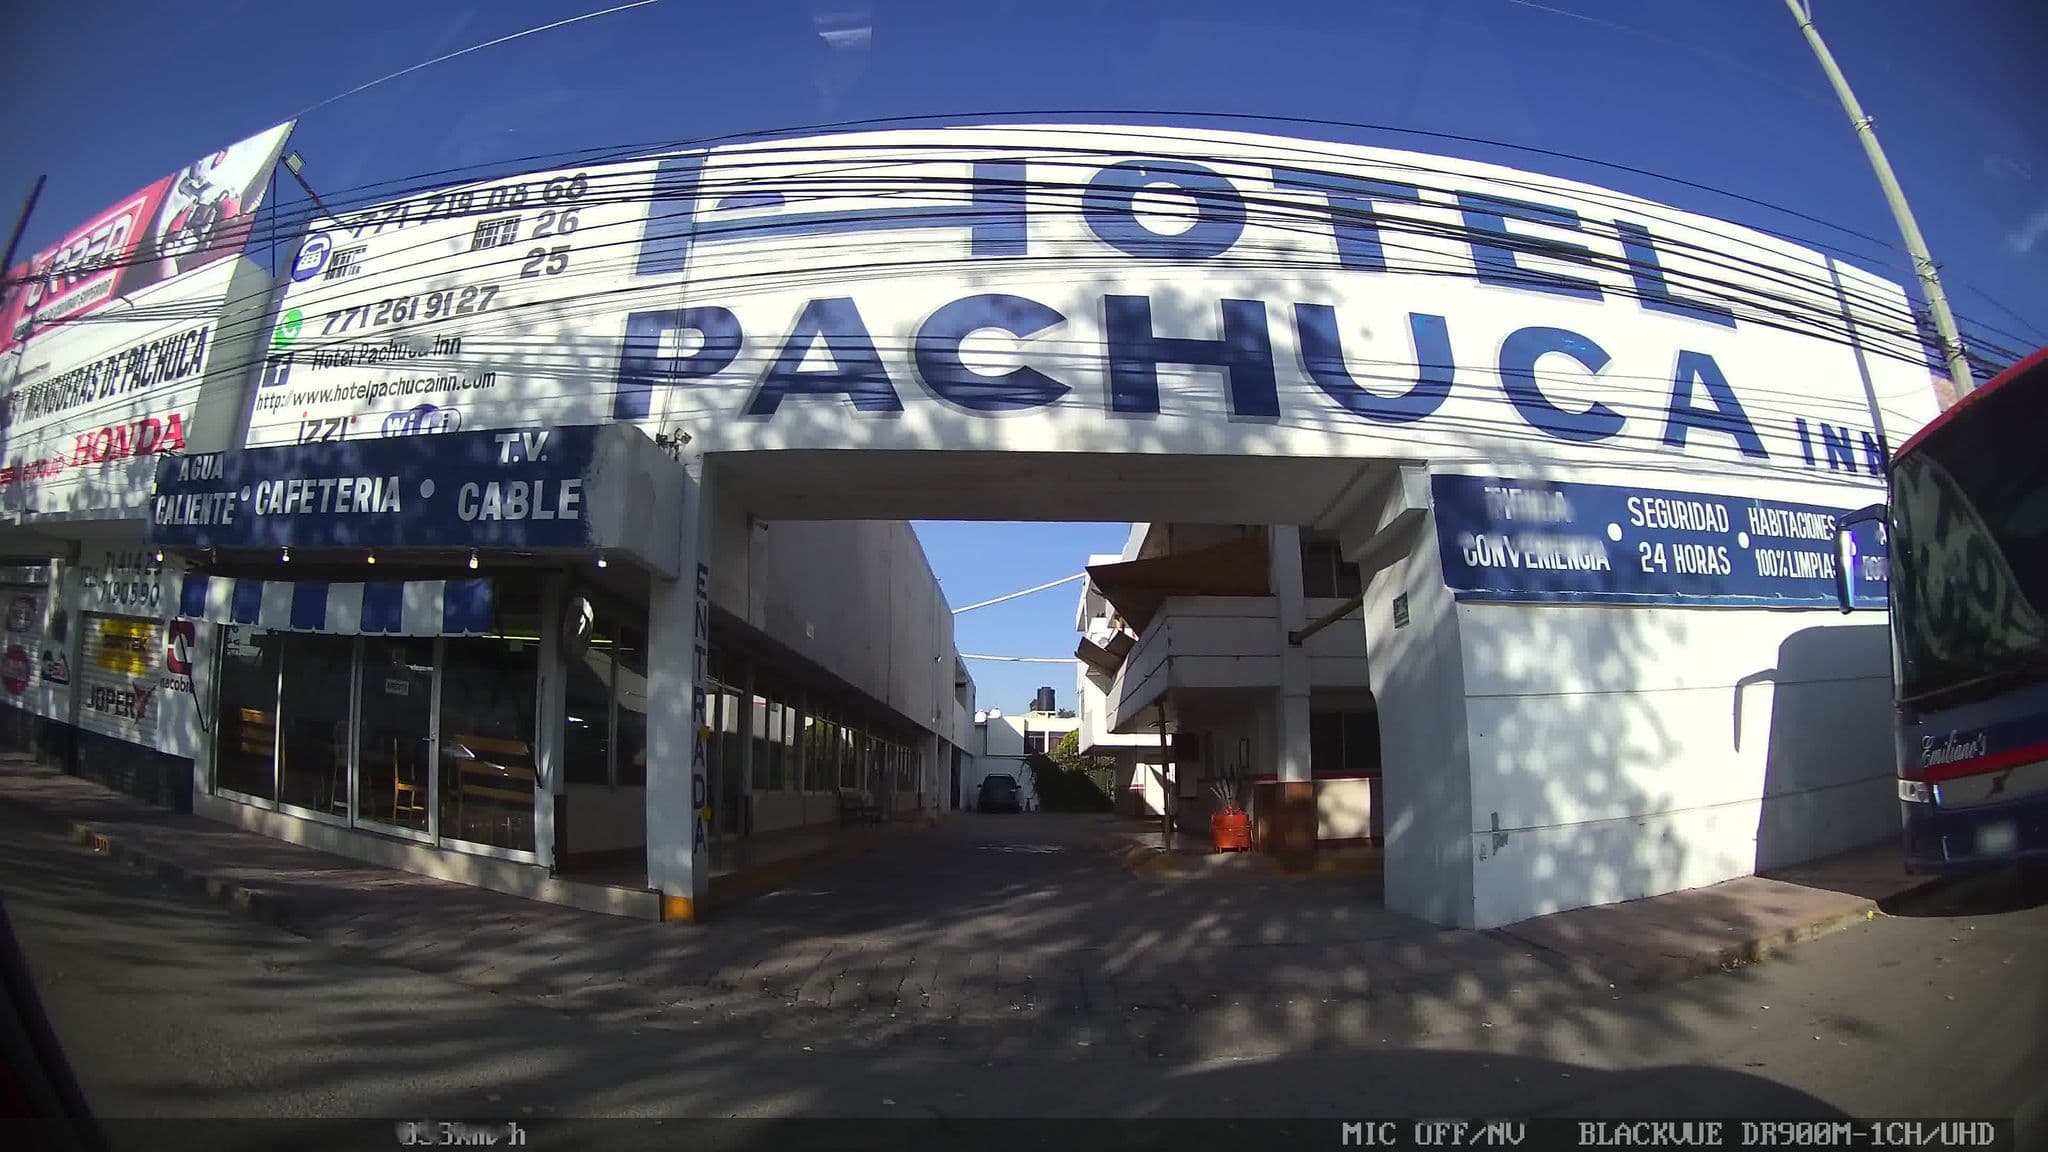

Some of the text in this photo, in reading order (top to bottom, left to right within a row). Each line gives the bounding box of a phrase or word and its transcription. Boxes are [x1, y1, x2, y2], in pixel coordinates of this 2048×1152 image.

[532, 207, 581, 240] 26
[636, 156, 1737, 329] HOTEL
[519, 244, 571, 279] 25
[321, 284, 500, 336] 771 261 91 27
[119, 325, 210, 394] PACHUCA
[311, 345, 357, 372] Hotel
[432, 333, 462, 356] Inn
[613, 292, 1886, 476] PACHUCA INN
[71, 412, 187, 468] HONDA
[494, 431, 550, 464] T.V.
[177, 454, 225, 481] AGUA
[154, 491, 238, 525] CALIENTE
[255, 475, 401, 516] CAFETERIA
[457, 478, 583, 522] CABLE
[1627, 496, 1730, 533] SEGURIDAD
[1748, 506, 1836, 542] HABITACIONES
[1639, 541, 1731, 576] 24 HORAS
[693, 560, 710, 854] ENTRADA
